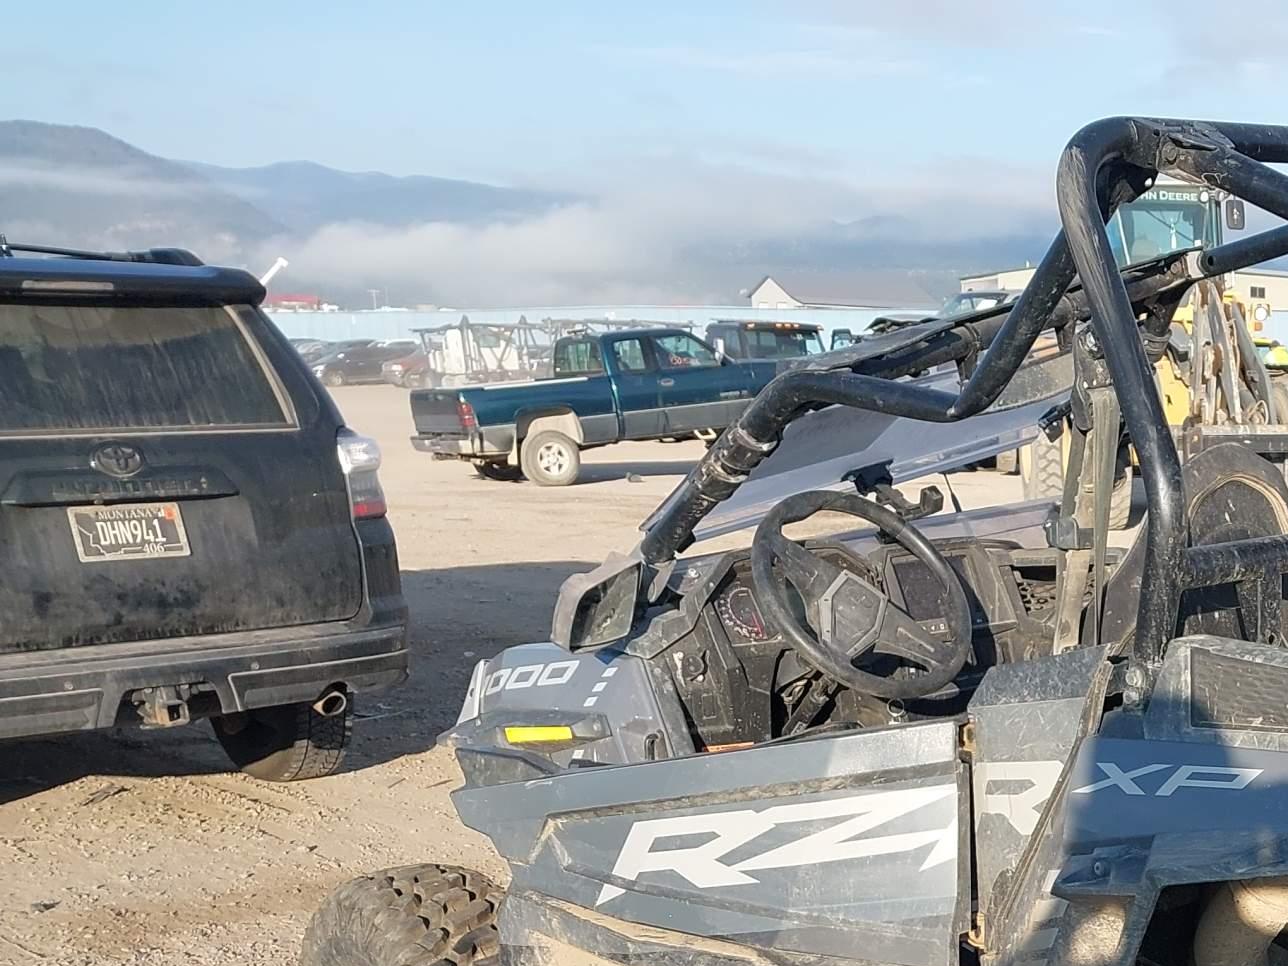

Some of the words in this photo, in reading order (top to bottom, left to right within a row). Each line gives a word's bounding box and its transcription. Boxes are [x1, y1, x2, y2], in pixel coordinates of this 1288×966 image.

[1160, 190, 1198, 200] DEERE
[97, 508, 152, 520] MONTANA
[96, 518, 167, 545] DHN941
[143, 544, 165, 554] 406
[1071, 762, 1265, 797] XP
